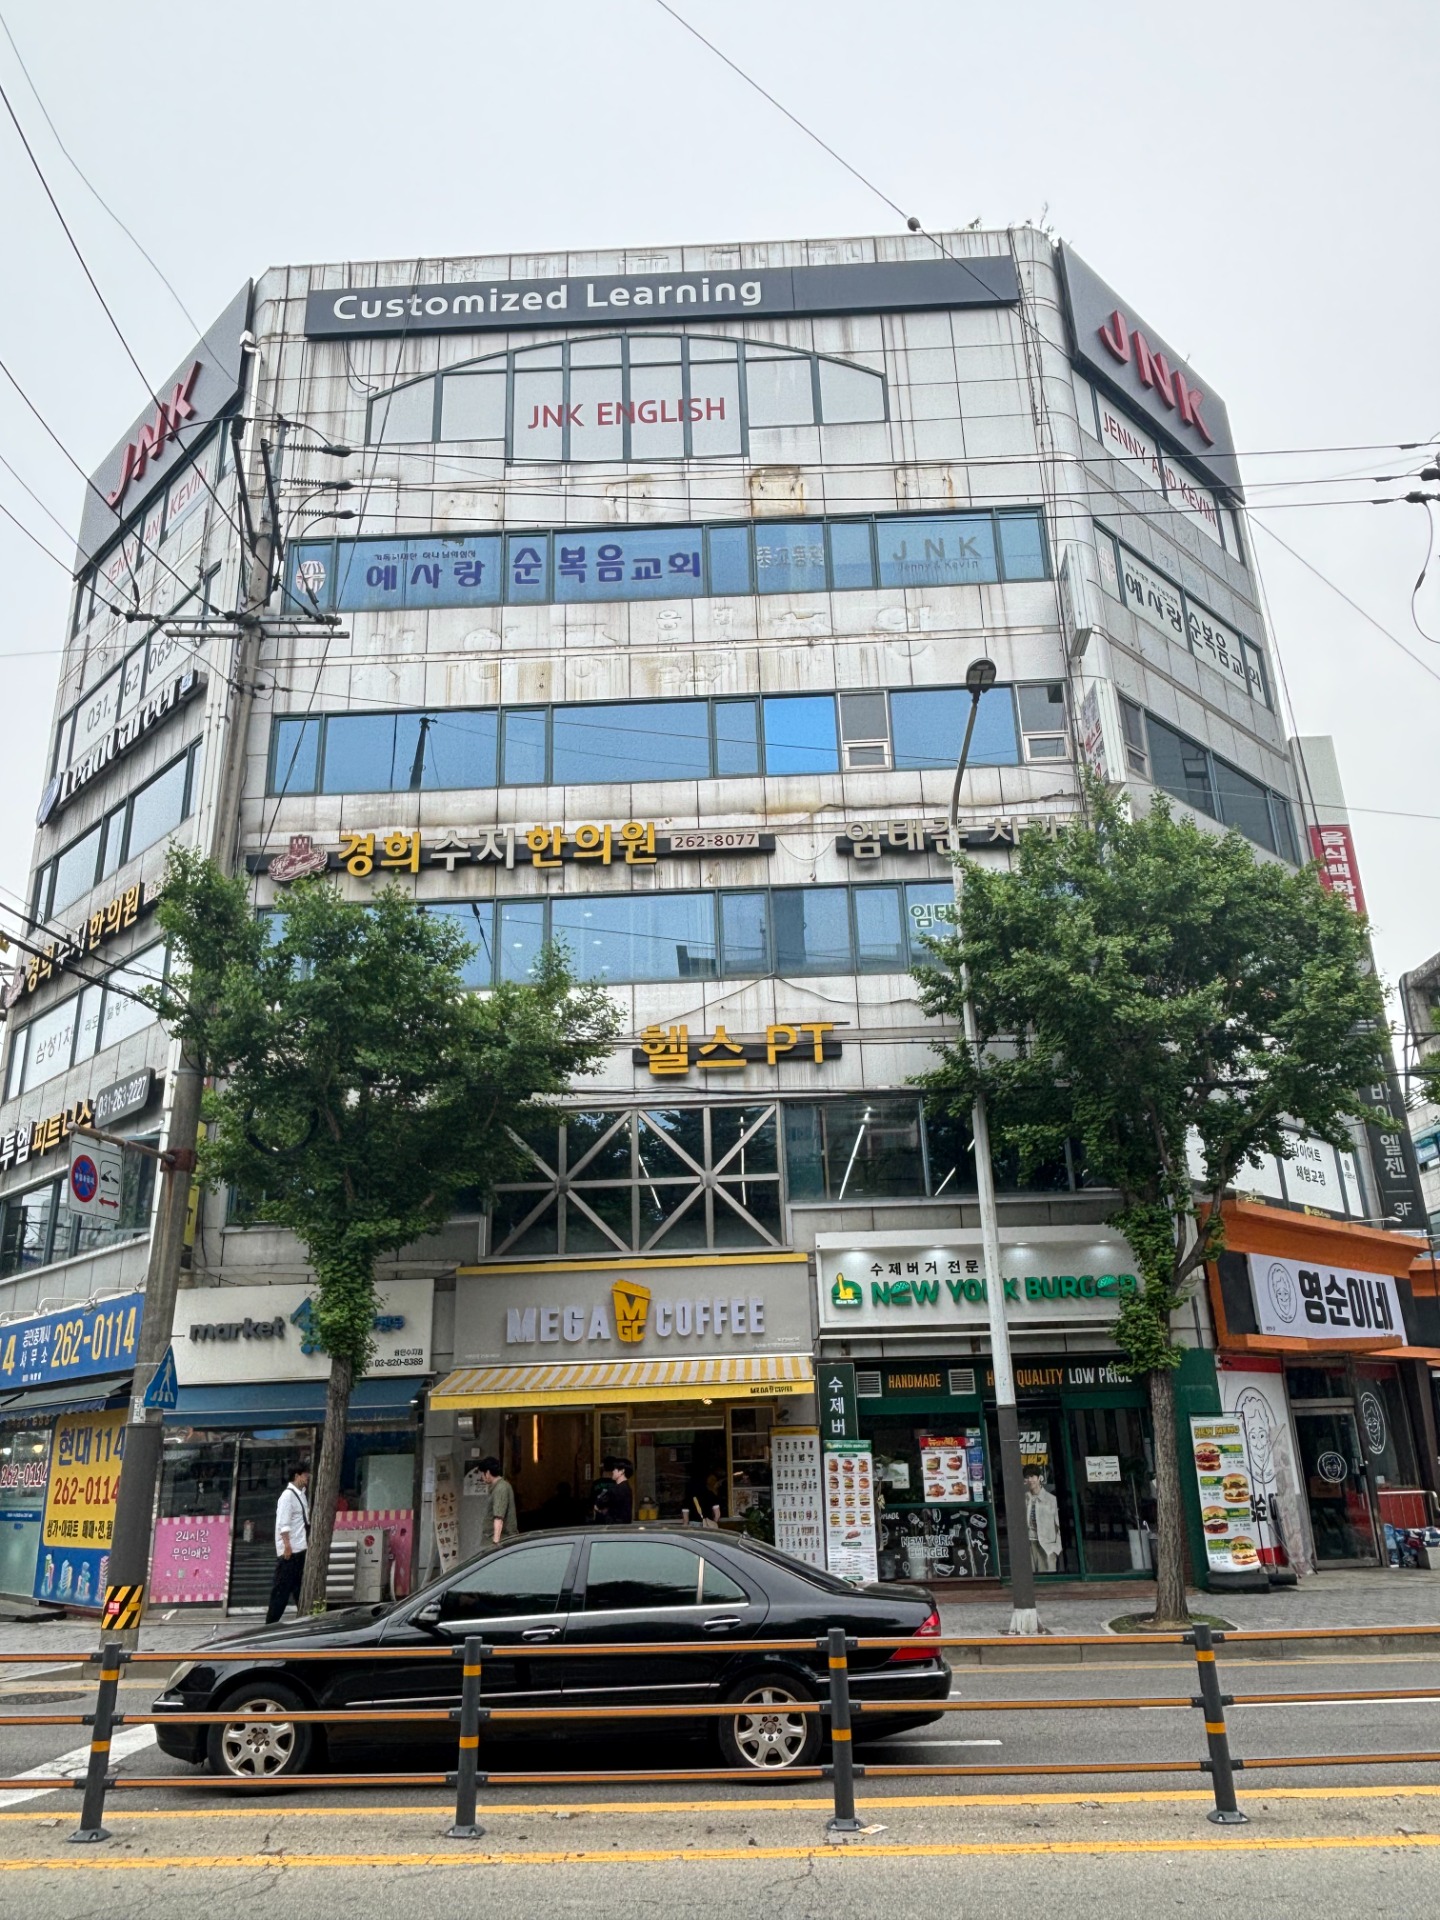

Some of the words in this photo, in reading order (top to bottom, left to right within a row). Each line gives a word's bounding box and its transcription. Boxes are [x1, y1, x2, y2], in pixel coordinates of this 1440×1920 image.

[333, 285, 568, 321] Customized
[586, 277, 763, 307] Learning
[1098, 309, 1215, 447] JNK
[105, 360, 202, 510] JNK
[528, 403, 584, 430] JNK
[597, 396, 726, 427] ENGLISH
[169, 459, 208, 520] KEVIN
[1103, 411, 1147, 466] JENNY
[1151, 453, 1177, 490] AND
[1178, 476, 1217, 528] KEVIN
[366, 560, 486, 591] 예사랑
[512, 544, 701, 585] 순복음교회
[892, 536, 982, 562] JNK
[1187, 611, 1263, 693] 순복음교회
[338, 821, 657, 878] 경희수지한의원
[673, 832, 757, 849] 262-8077
[640, 1025, 748, 1075] 헬스
[766, 1022, 834, 1067] PT
[1394, 1202, 1413, 1217] 3F
[870, 1260, 938, 1277] 수제버거
[870, 1280, 940, 1306] NEW
[945, 1277, 1020, 1302] YOK
[1298, 1269, 1394, 1331] 영순이네
[50, 1306, 137, 1368] 262-0114
[189, 1316, 285, 1342] market
[506, 1304, 612, 1343] MEGA
[655, 1298, 766, 1337] COFFEE
[888, 1372, 942, 1389] HANDMADE
[1016, 1368, 1064, 1388] QUALITY
[1068, 1367, 1096, 1384] LOW
[172, 1546, 211, 1561] 무인매장
[175, 1529, 210, 1543] 24시간
